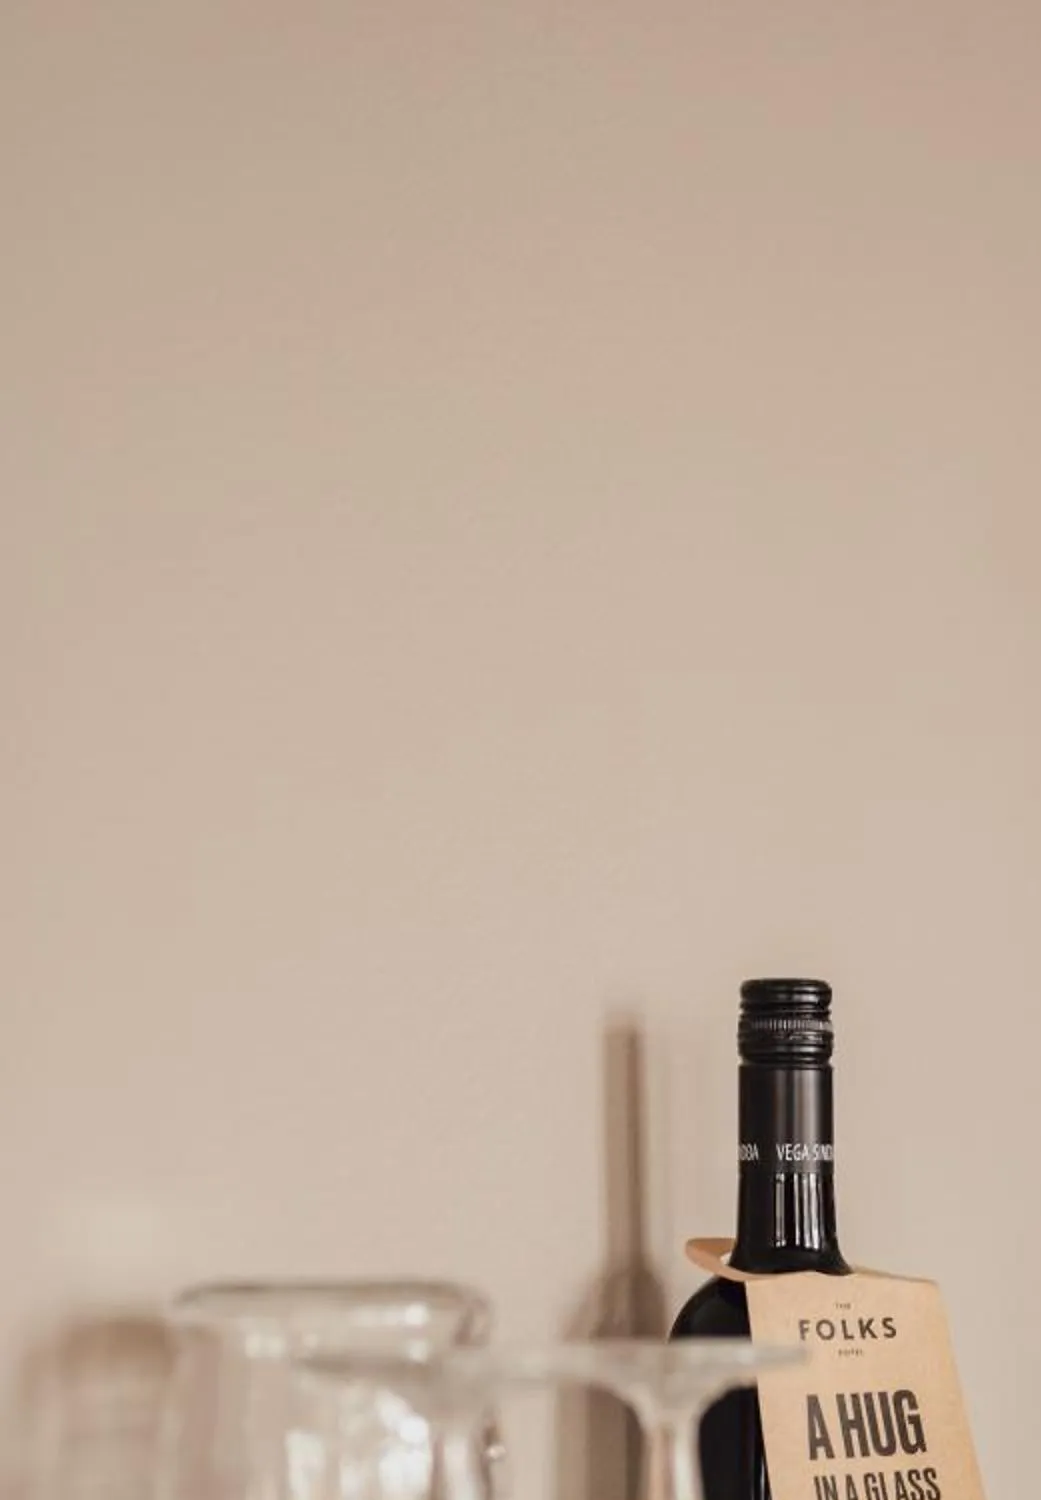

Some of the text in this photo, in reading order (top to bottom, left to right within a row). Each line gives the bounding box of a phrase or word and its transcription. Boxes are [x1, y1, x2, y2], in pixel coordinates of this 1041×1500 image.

[775, 1143, 809, 1161] VEGA
[799, 1317, 897, 1341] FOLKS
[806, 1389, 927, 1461] A HUG
